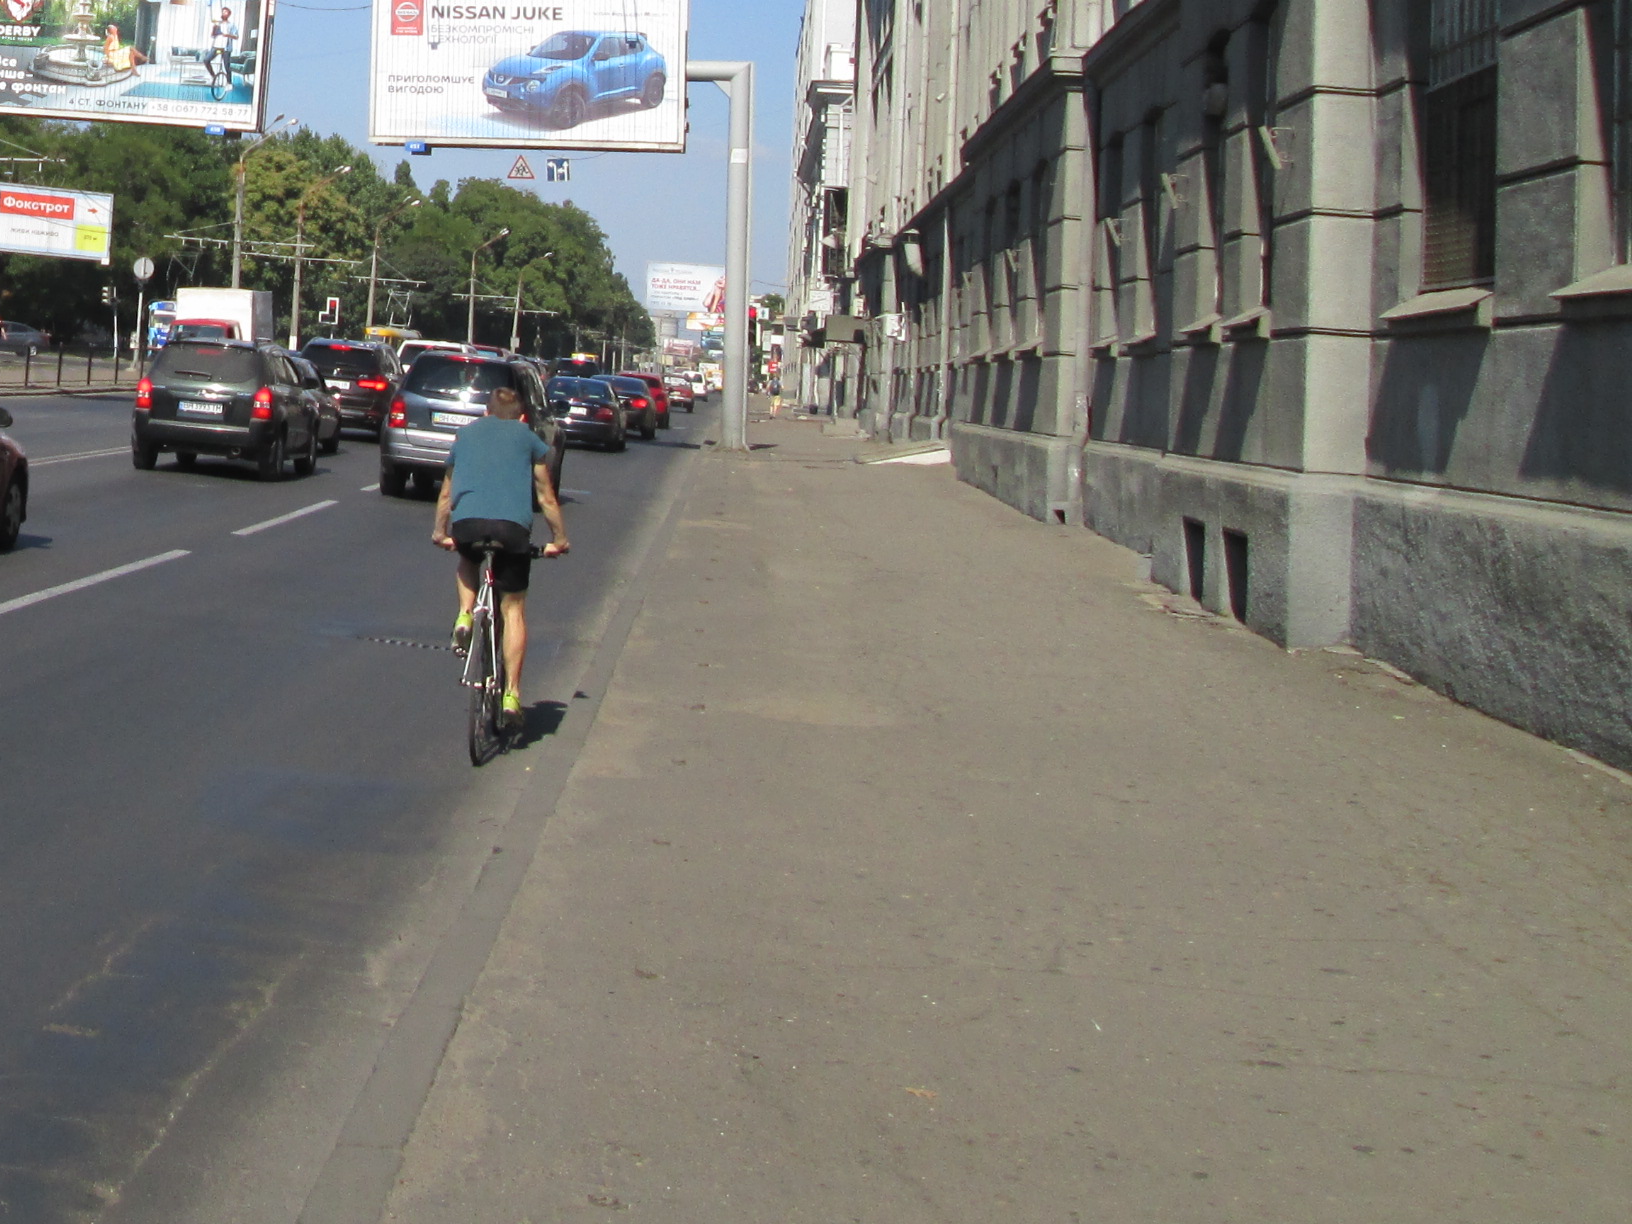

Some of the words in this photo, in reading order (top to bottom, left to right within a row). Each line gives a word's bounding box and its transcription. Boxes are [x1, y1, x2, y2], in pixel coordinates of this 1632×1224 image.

[431, 5, 506, 20] NISSAN
[511, 6, 564, 21] JUKE
[430, 24, 534, 35] БЕЗКОМПРОМІСНІ
[430, 34, 498, 45] ТЕХНОЛОГІЇ
[387, 74, 475, 84] ПРИГОЛОМШУЄ
[11, 82, 67, 94] фонтан
[387, 84, 444, 95] ВИГОДОЮ
[95, 99, 148, 110] ФОНТАНУ
[2, 195, 70, 214] Фокстрот
